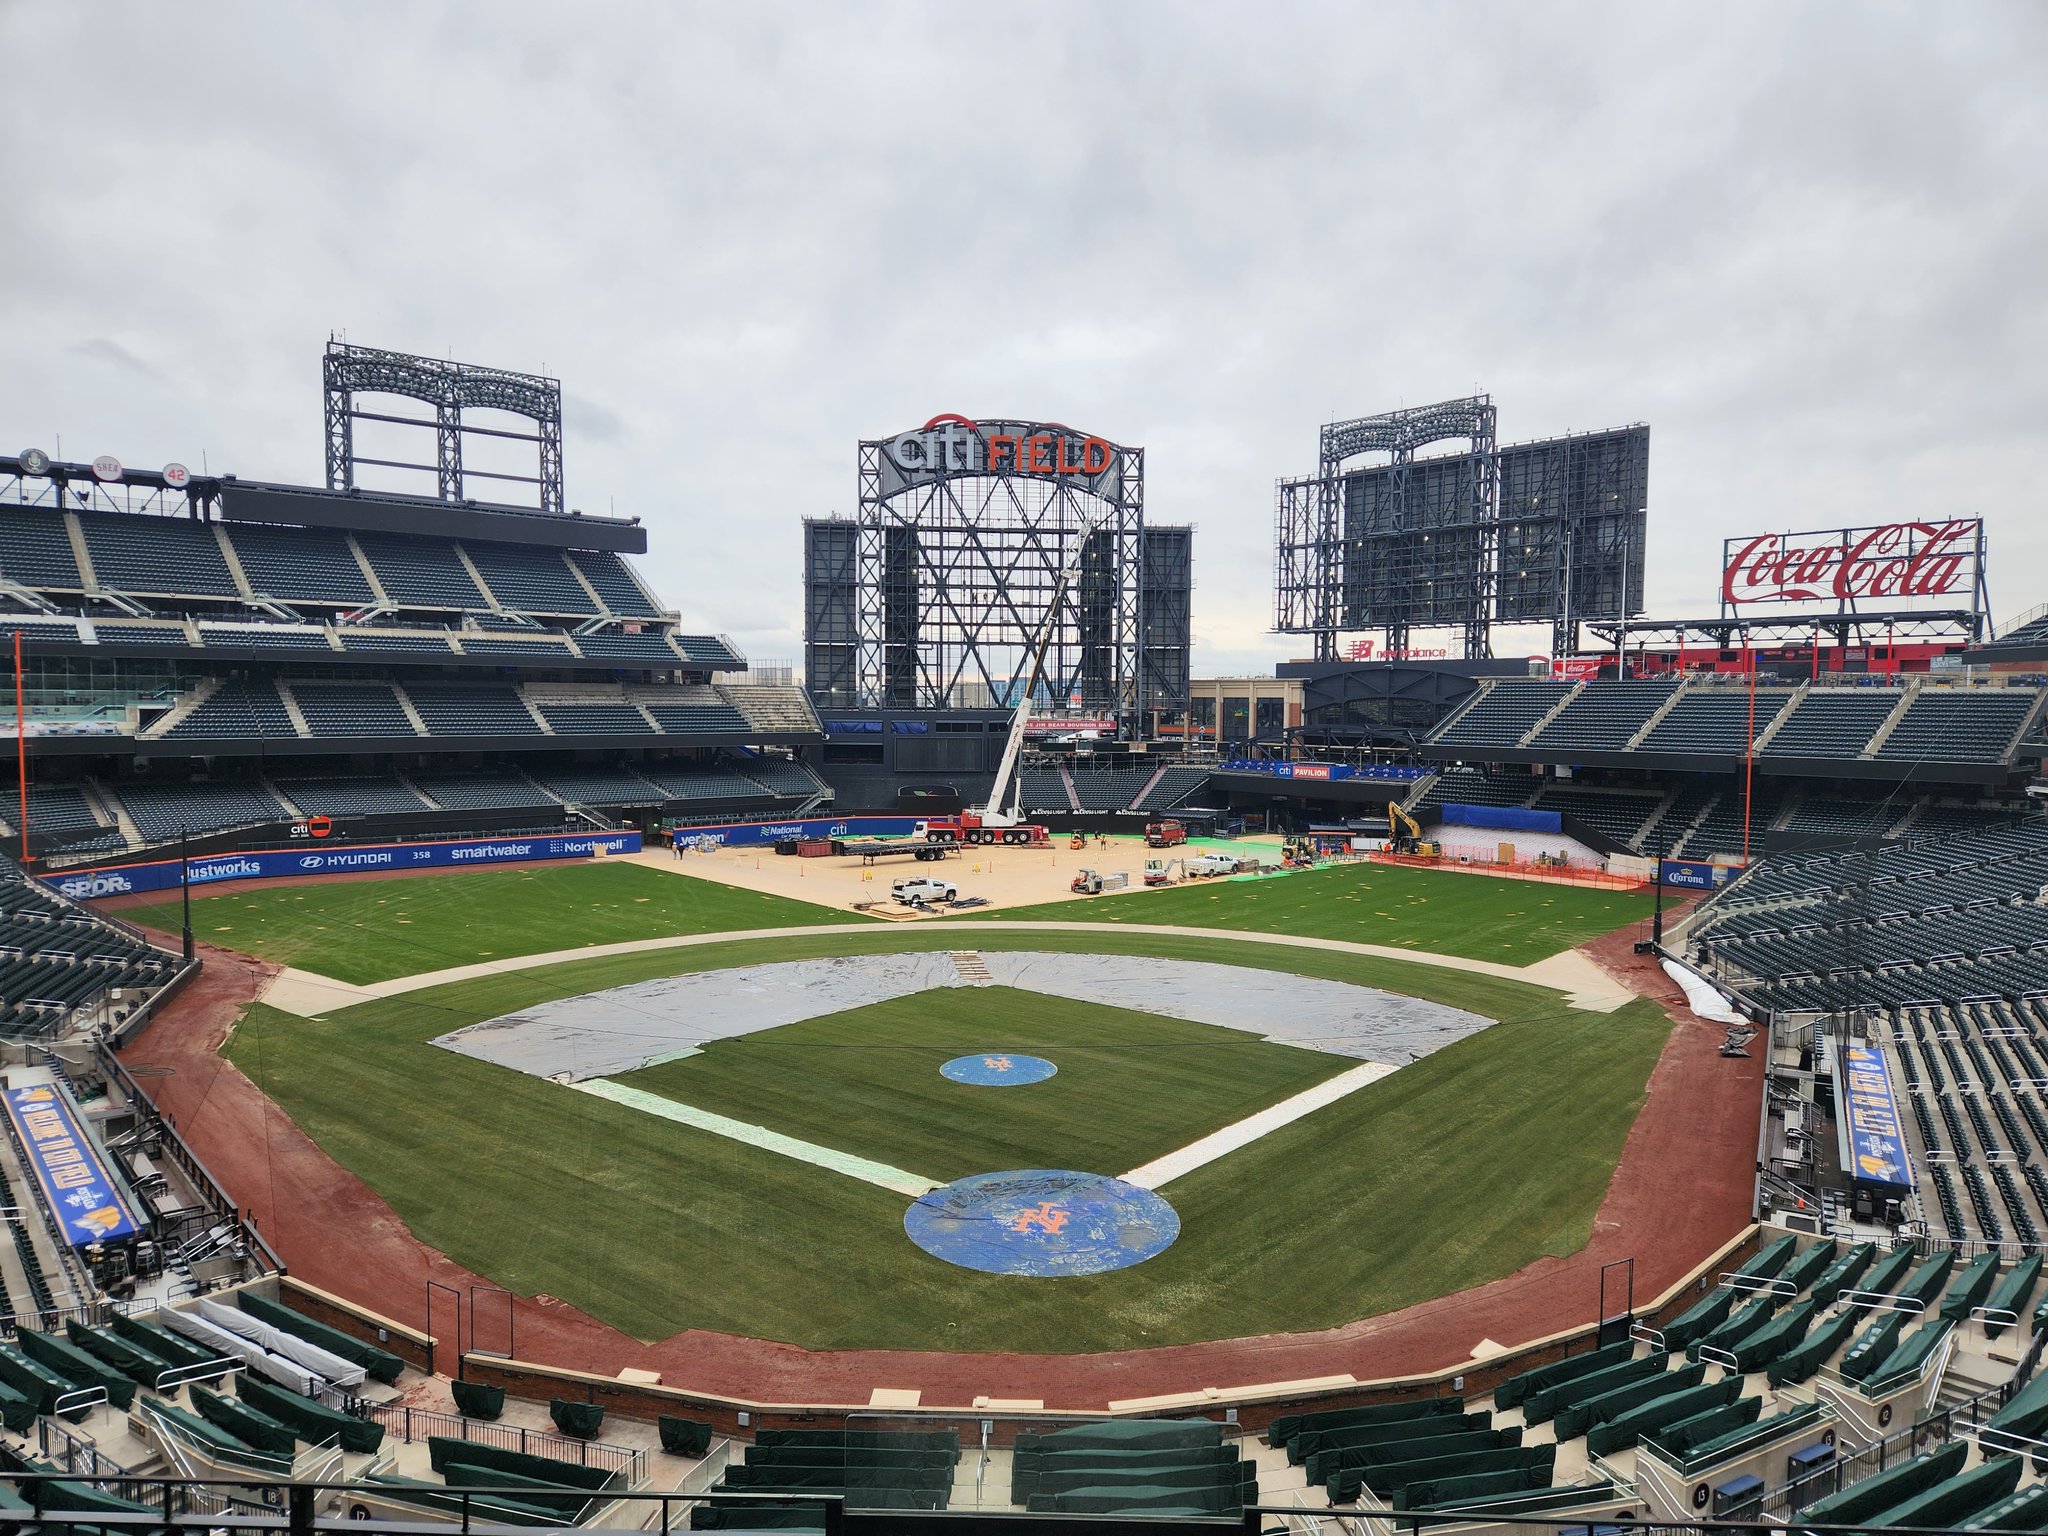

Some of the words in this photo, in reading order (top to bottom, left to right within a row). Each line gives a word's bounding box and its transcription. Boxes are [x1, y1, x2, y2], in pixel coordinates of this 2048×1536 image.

[988, 435, 1111, 474] FIELD
[96, 463, 118, 473] SHEA
[168, 469, 185, 481] 42
[1376, 650, 1398, 658] new
[1400, 647, 1447, 658] balance
[1279, 765, 1291, 775] citi
[1295, 768, 1327, 777] PAVILION
[291, 823, 308, 834] citi
[770, 825, 803, 835] National
[830, 823, 847, 835] citi
[681, 833, 725, 846] veron
[413, 851, 431, 860] 358
[451, 844, 532, 860] smartwater
[328, 853, 392, 866] HYUNDAI
[1668, 872, 1705, 884] Corona
[1852, 1094, 1890, 1108] GO
[23, 1109, 70, 1141] WELCOME
[37, 1137, 75, 1152] TO
[42, 1148, 83, 1168] CITI
[50, 1163, 95, 1189] FIELD
[267, 1491, 277, 1503] 18
[1698, 1490, 1706, 1503] 13
